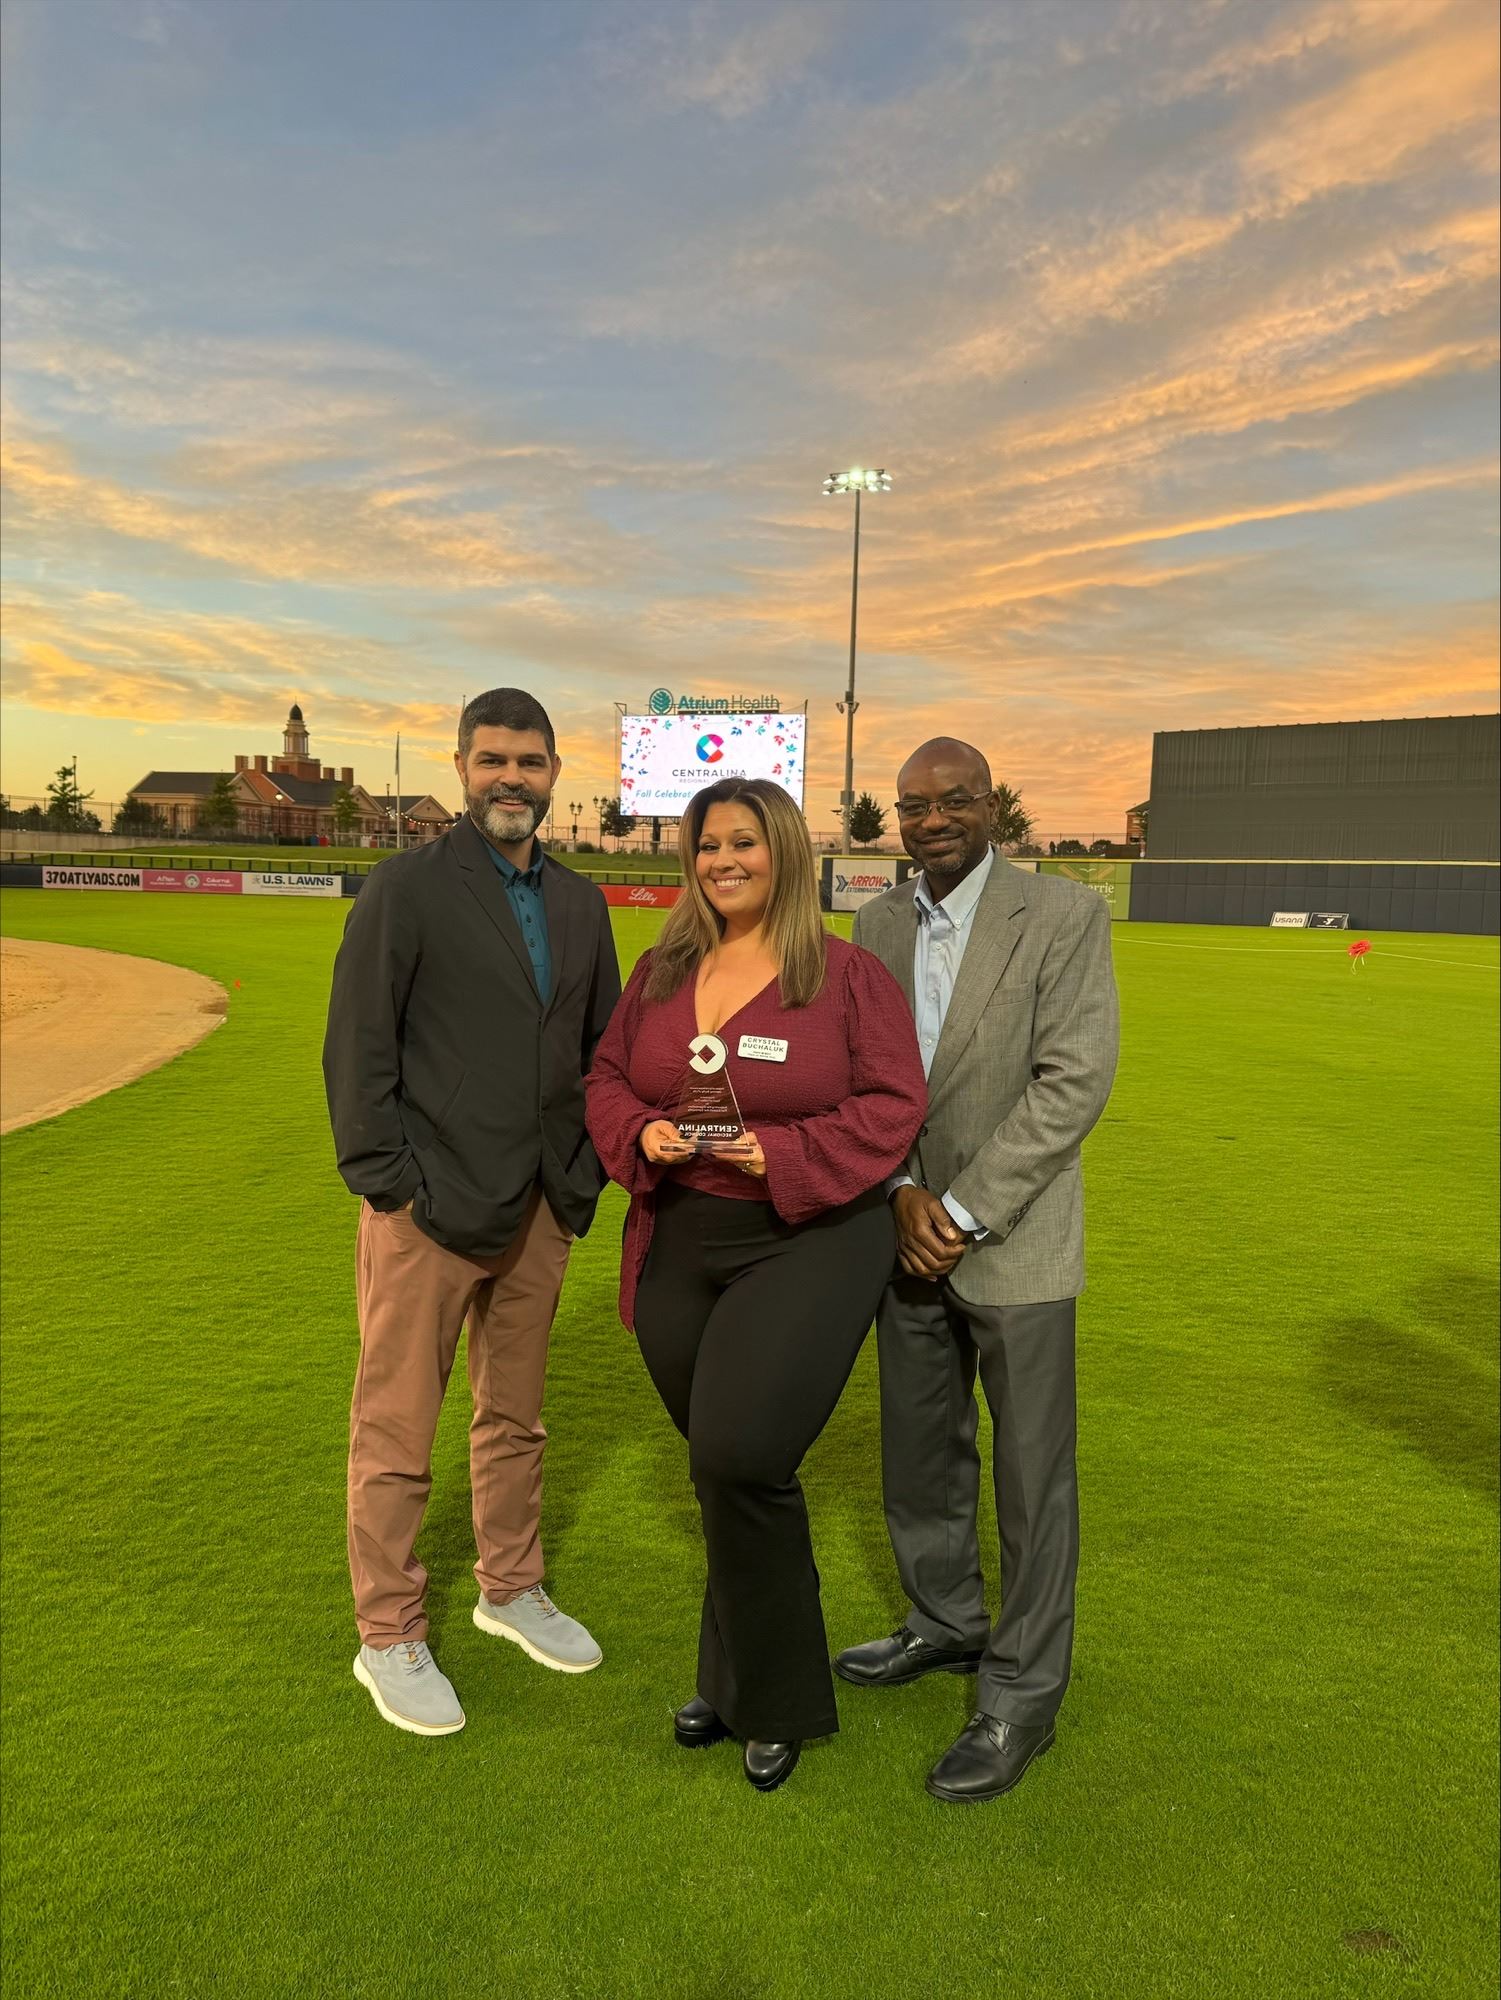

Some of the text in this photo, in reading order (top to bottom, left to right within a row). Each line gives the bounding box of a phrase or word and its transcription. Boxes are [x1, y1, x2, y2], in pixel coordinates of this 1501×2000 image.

[678, 694, 780, 709] Atrium Health
[672, 769, 747, 777] CENTRALINA
[635, 789, 652, 798] Fall
[46, 871, 140, 887] 370ATLYADS.COM
[262, 875, 334, 886] U.S. LAWNS
[848, 875, 886, 887] ARROW
[628, 887, 658, 905] Lilly
[742, 1042, 784, 1052] BUCHALUK
[747, 1037, 780, 1046] CRYSTAL
